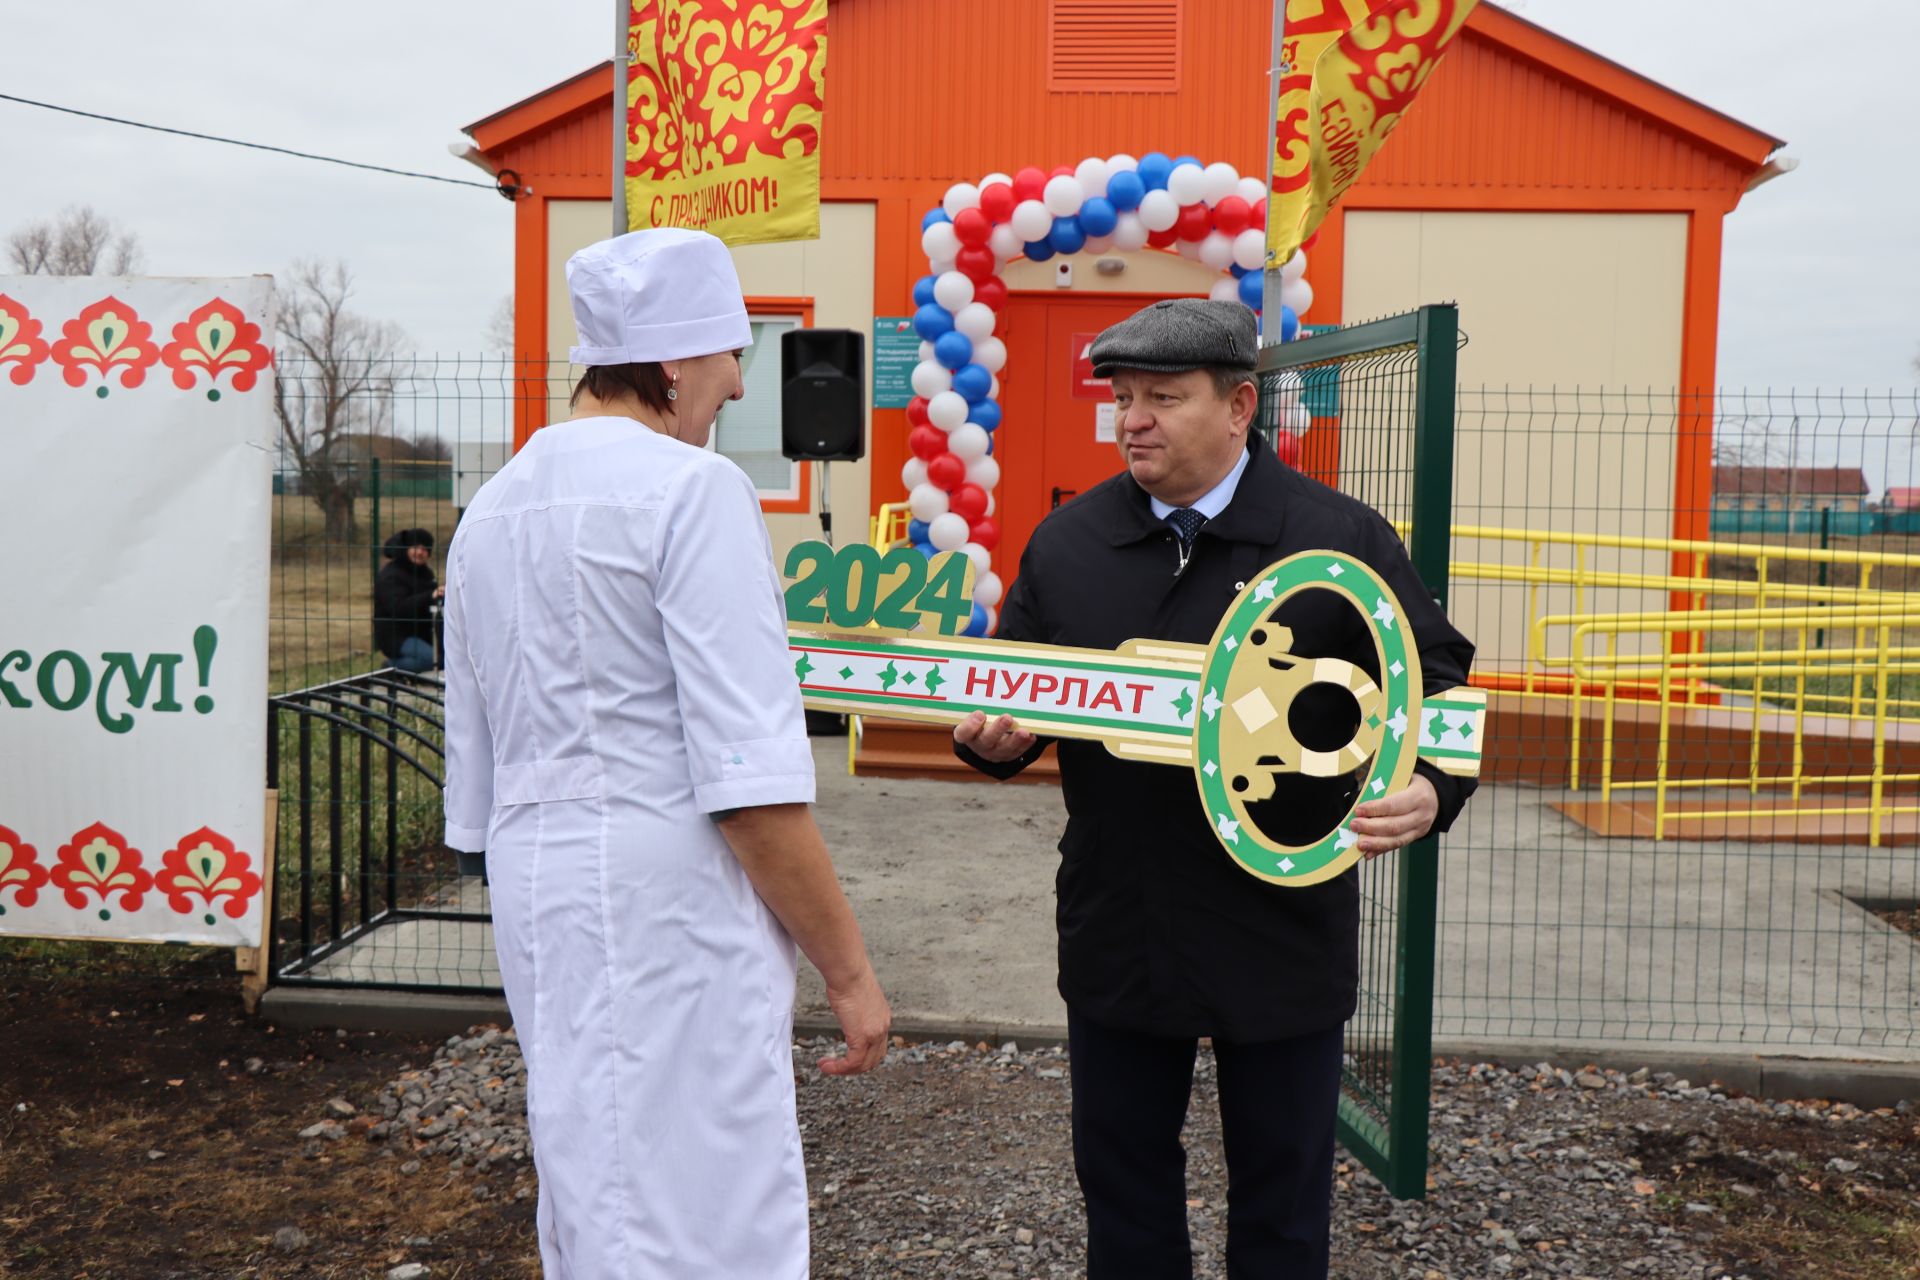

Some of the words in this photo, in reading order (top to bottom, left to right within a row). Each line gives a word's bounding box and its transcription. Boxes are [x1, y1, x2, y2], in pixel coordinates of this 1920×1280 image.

[650, 194, 664, 228] С
[667, 175, 778, 230] ПРАЗДНИКОМ!
[784, 540, 974, 636] 2024
[965, 666, 1154, 714] НУРЛАТ
